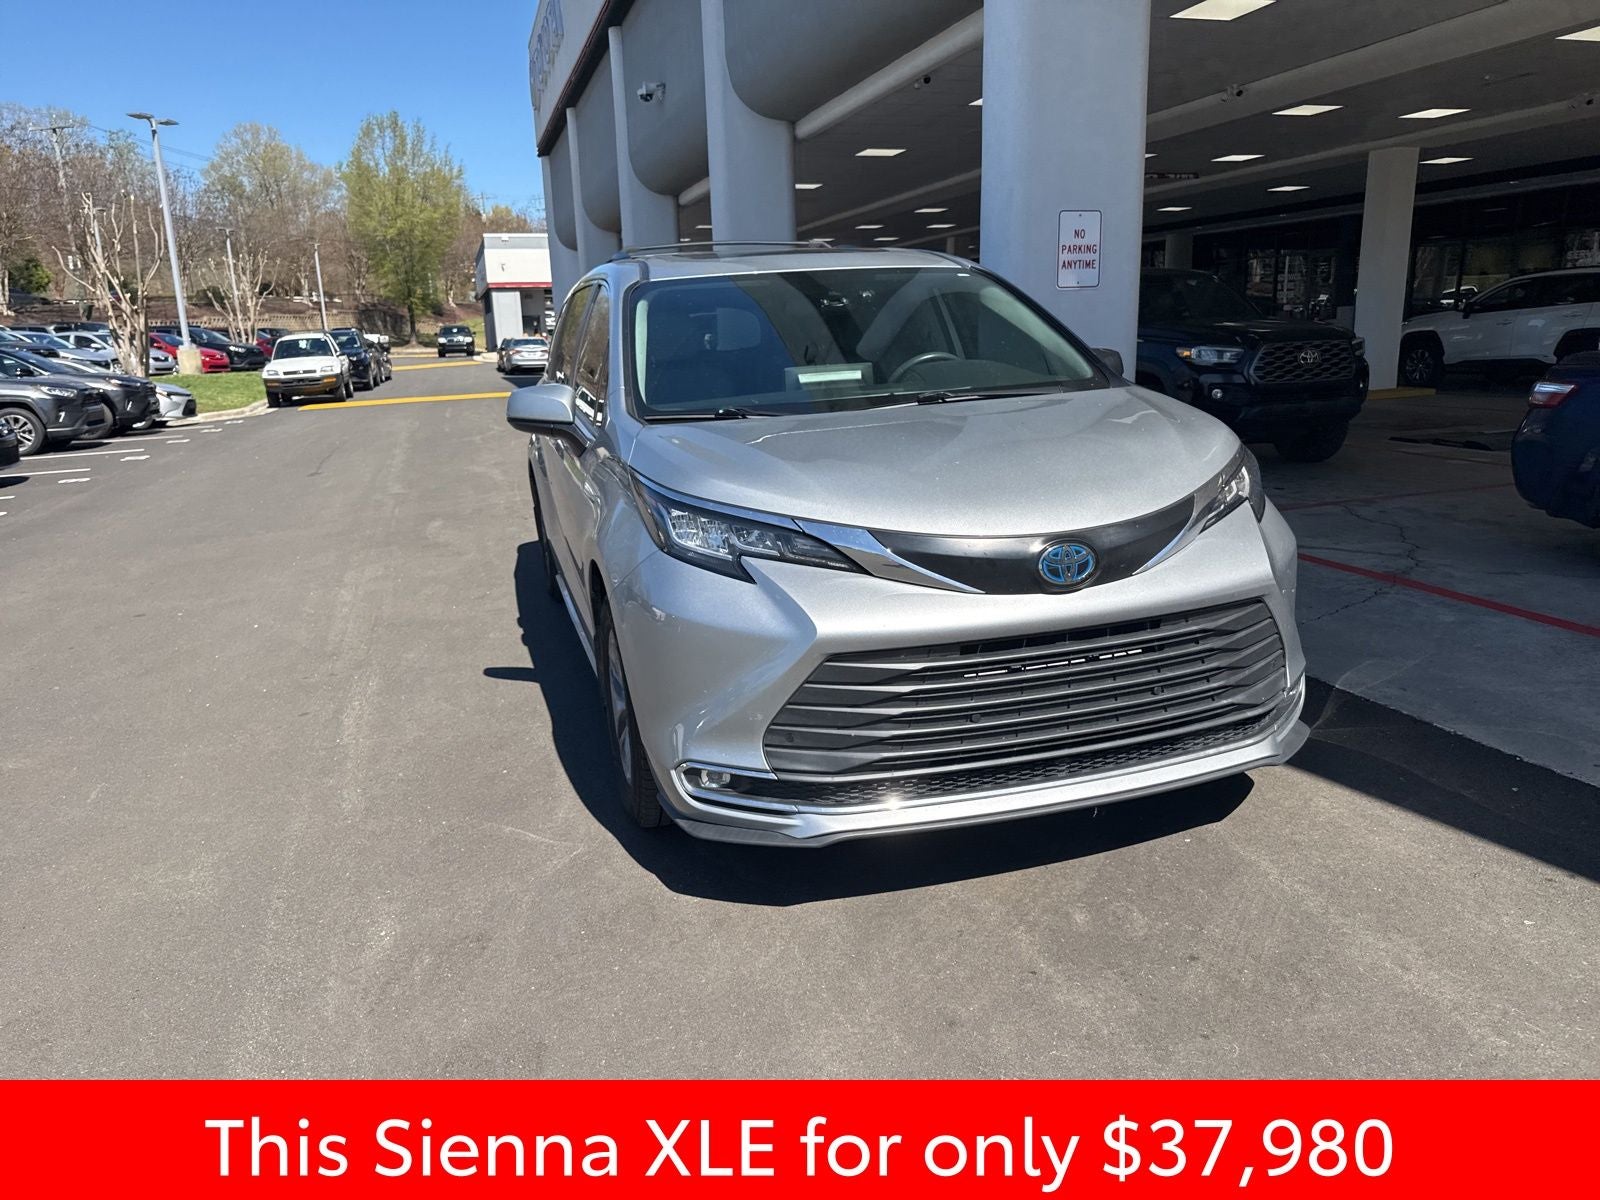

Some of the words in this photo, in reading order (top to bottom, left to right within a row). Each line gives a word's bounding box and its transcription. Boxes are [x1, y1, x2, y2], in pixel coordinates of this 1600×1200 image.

[1074, 228, 1086, 239] NO
[1061, 244, 1097, 255] PARKING
[1061, 259, 1097, 270] ANYTIME
